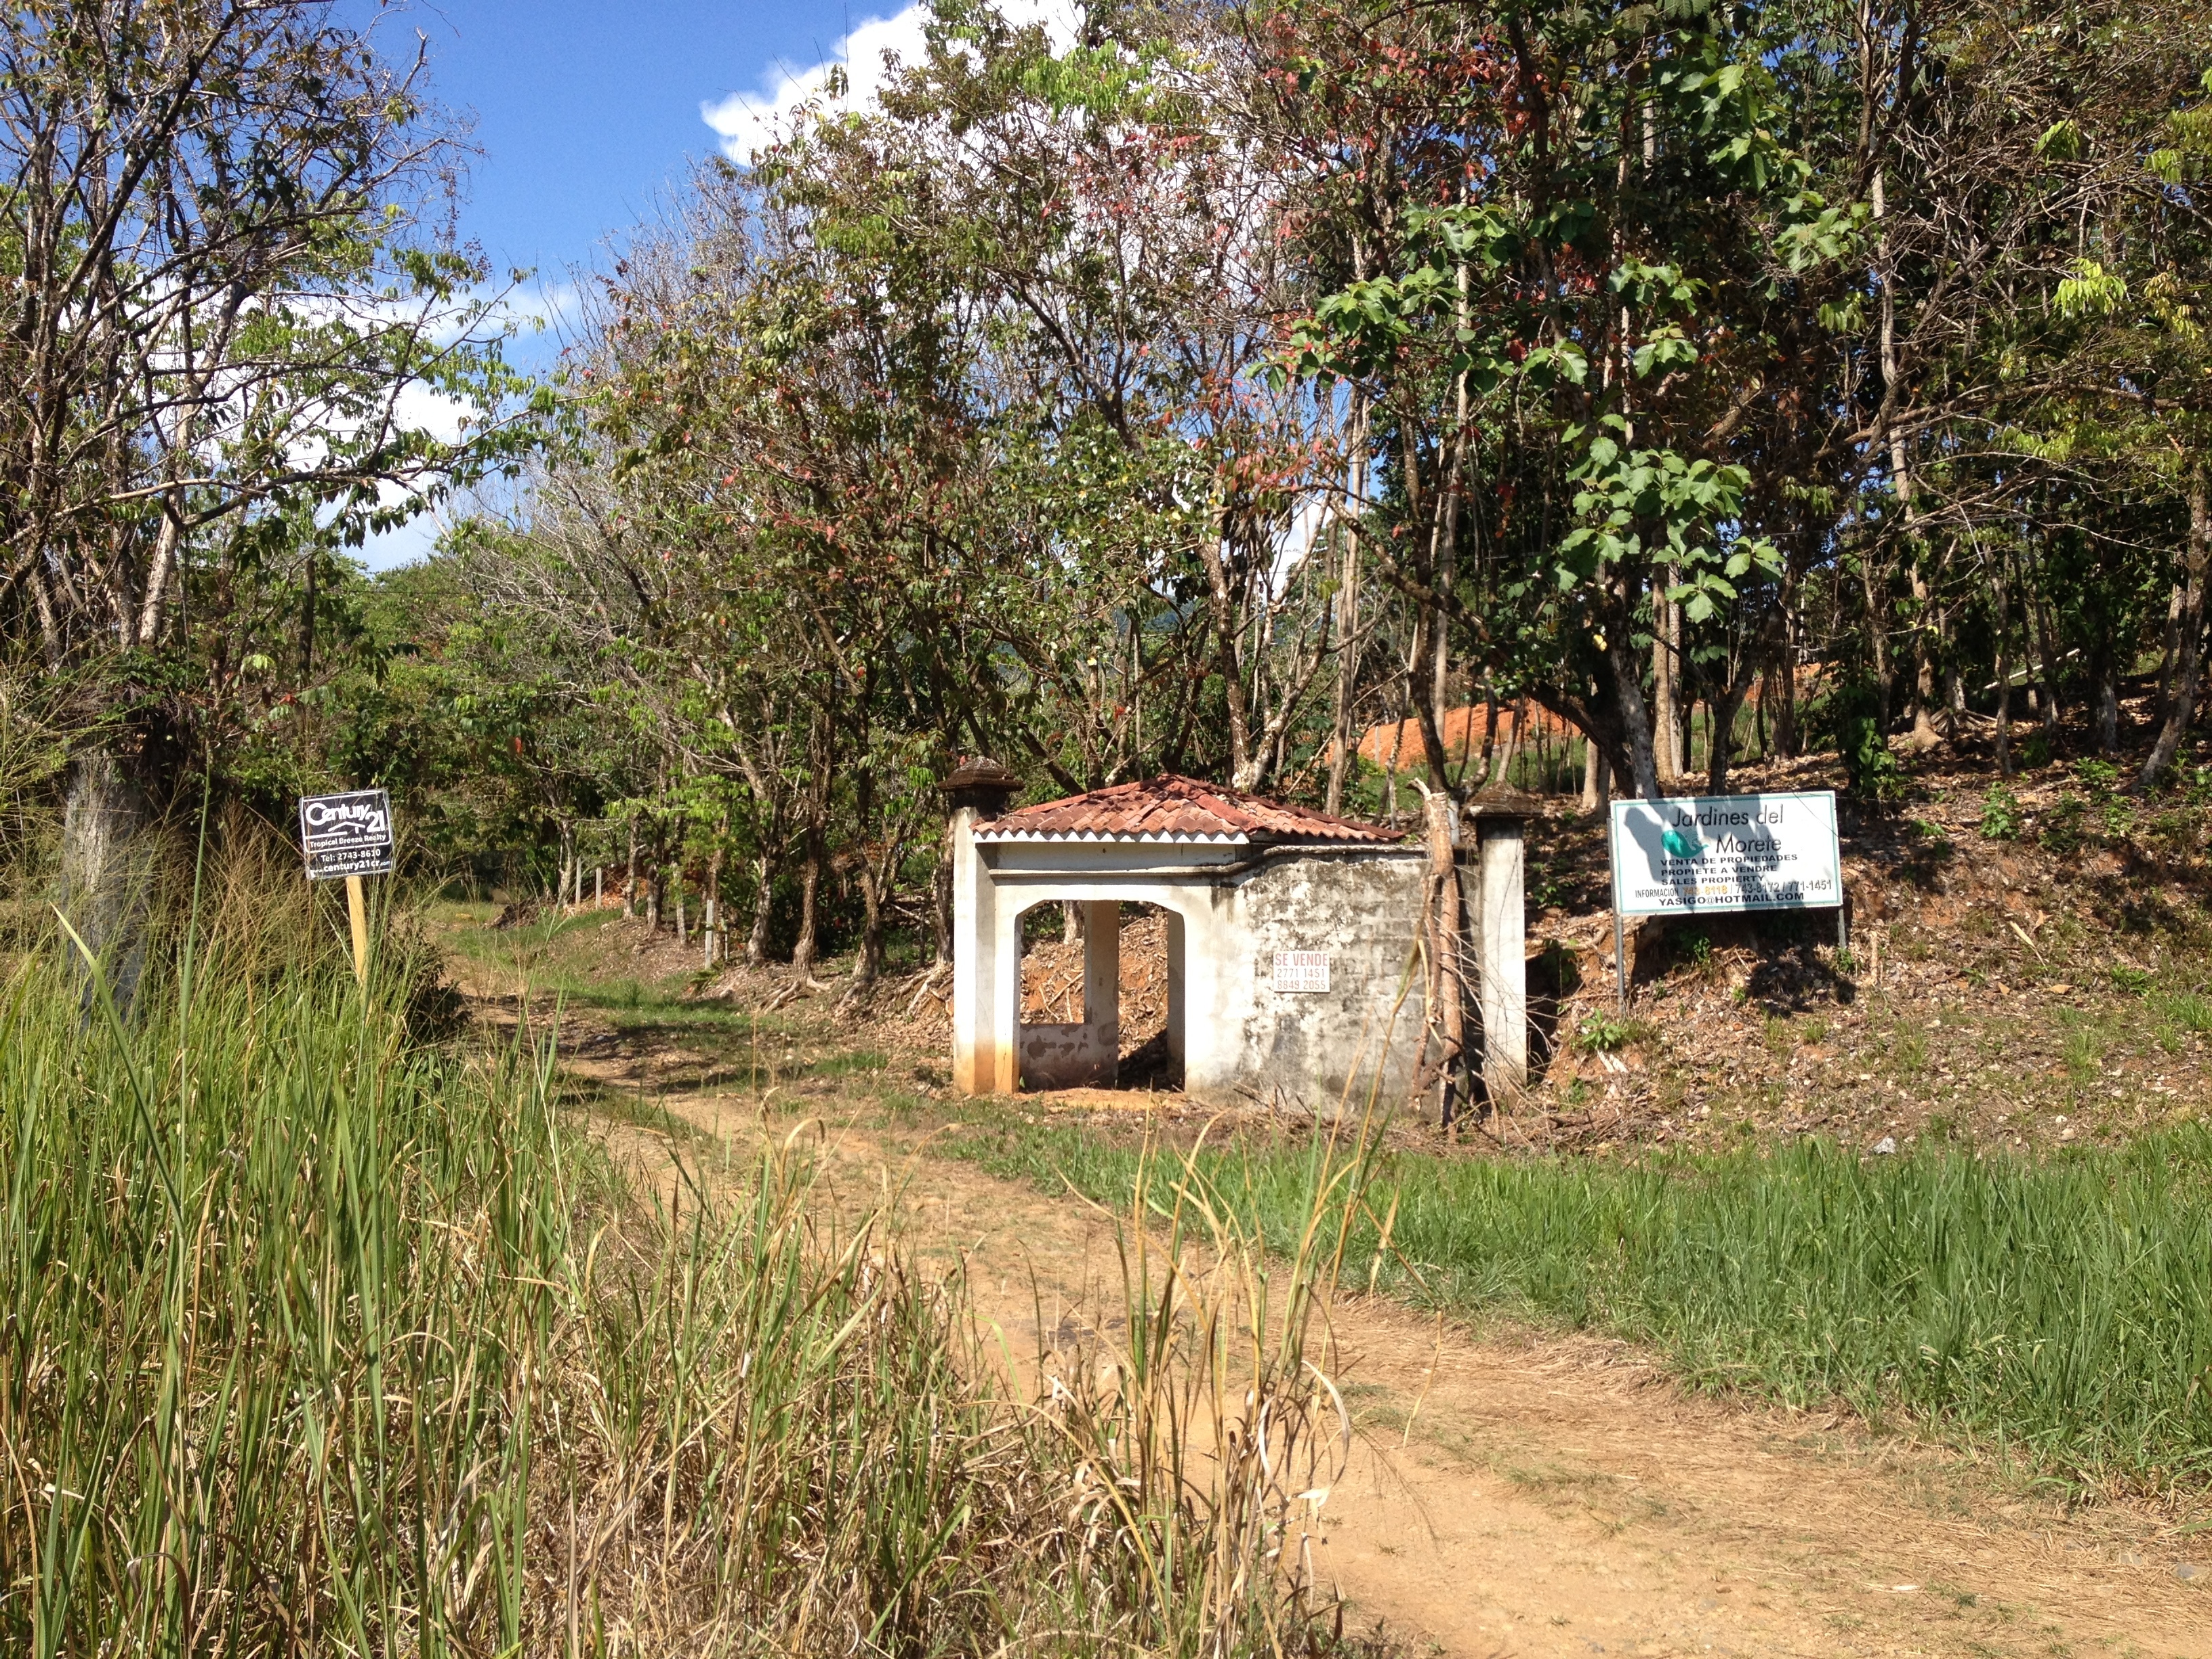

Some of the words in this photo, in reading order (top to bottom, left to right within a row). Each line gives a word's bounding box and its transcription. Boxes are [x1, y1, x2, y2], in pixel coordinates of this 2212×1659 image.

[306, 802, 371, 825] Century
[365, 811, 385, 833] 21
[1672, 806, 1749, 827] Jardines
[1756, 804, 1783, 825] del
[310, 838, 337, 848] Tropical
[339, 836, 363, 845] Breeze
[364, 834, 386, 842] Realty
[1716, 834, 1782, 854] Morete
[321, 855, 335, 863] Tel:
[337, 849, 381, 861] 2743-8610
[1660, 858, 1698, 866] VENTA
[1721, 854, 1798, 864] PROPIEDADES
[1661, 867, 1717, 876] PROPIETE
[1732, 865, 1777, 874] VENDRE
[1662, 878, 1697, 886] SALES
[1702, 875, 1765, 884] PROPIERTY
[1736, 882, 1780, 894] 743-8172
[1788, 879, 1832, 891] 771-1451
[1659, 893, 1804, 906] YASIGO@HOTMAIL.COM
[1275, 953, 1288, 966] SE
[1293, 953, 1328, 966] VENDE
[1277, 968, 1298, 978] 2771
[1304, 968, 1324, 978] 1451
[1277, 980, 1300, 989] 8849
[1303, 980, 1326, 989] 2055
